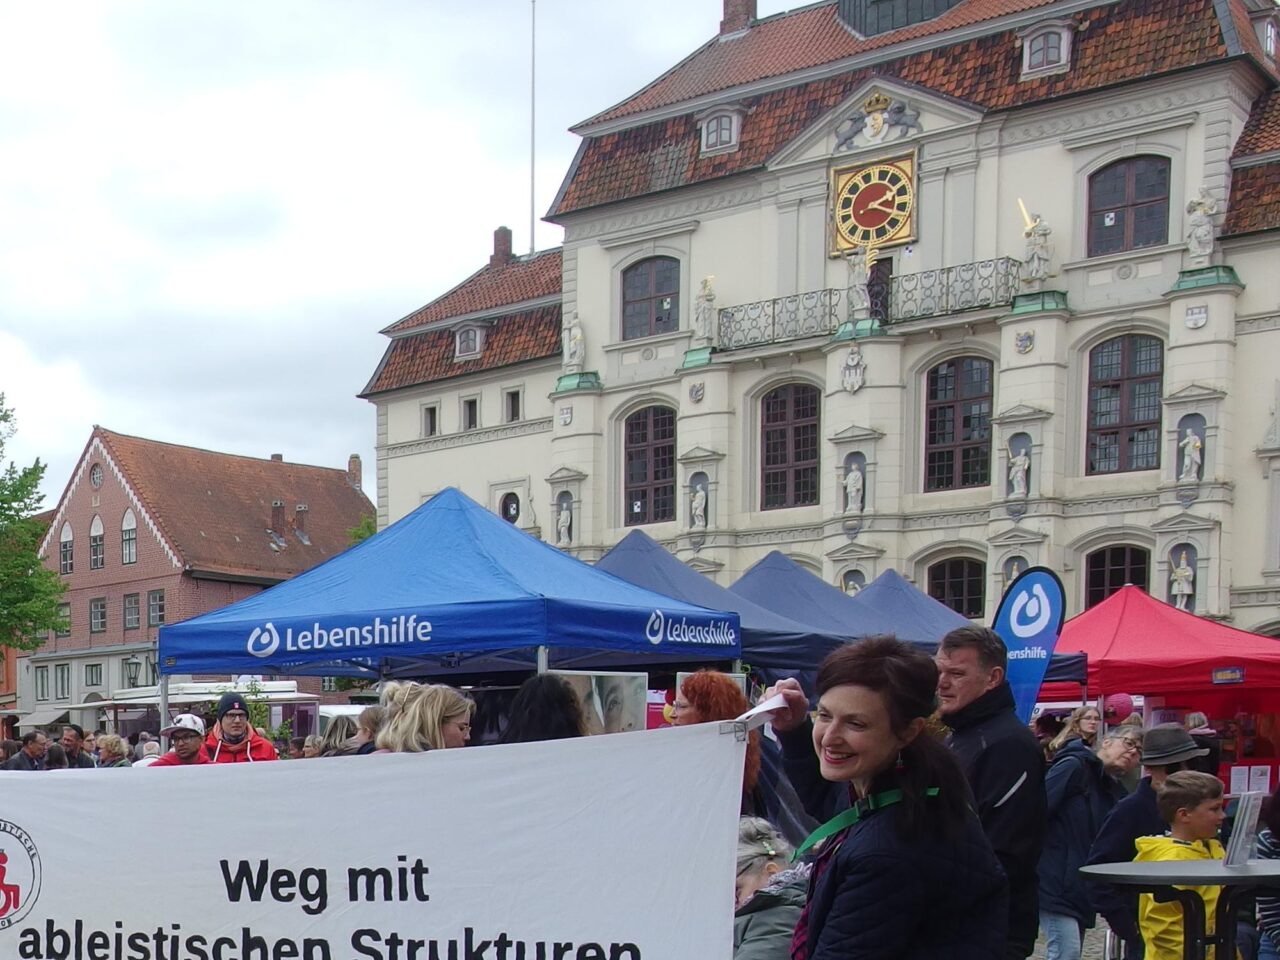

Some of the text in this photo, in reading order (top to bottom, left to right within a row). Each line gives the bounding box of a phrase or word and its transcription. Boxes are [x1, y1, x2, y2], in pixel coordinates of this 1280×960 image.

[286, 614, 432, 651] Lebenshilfe
[667, 617, 736, 645] Lebenshilfe
[1007, 646, 1047, 659] enshilfe
[220, 855, 429, 915] Weg mit
